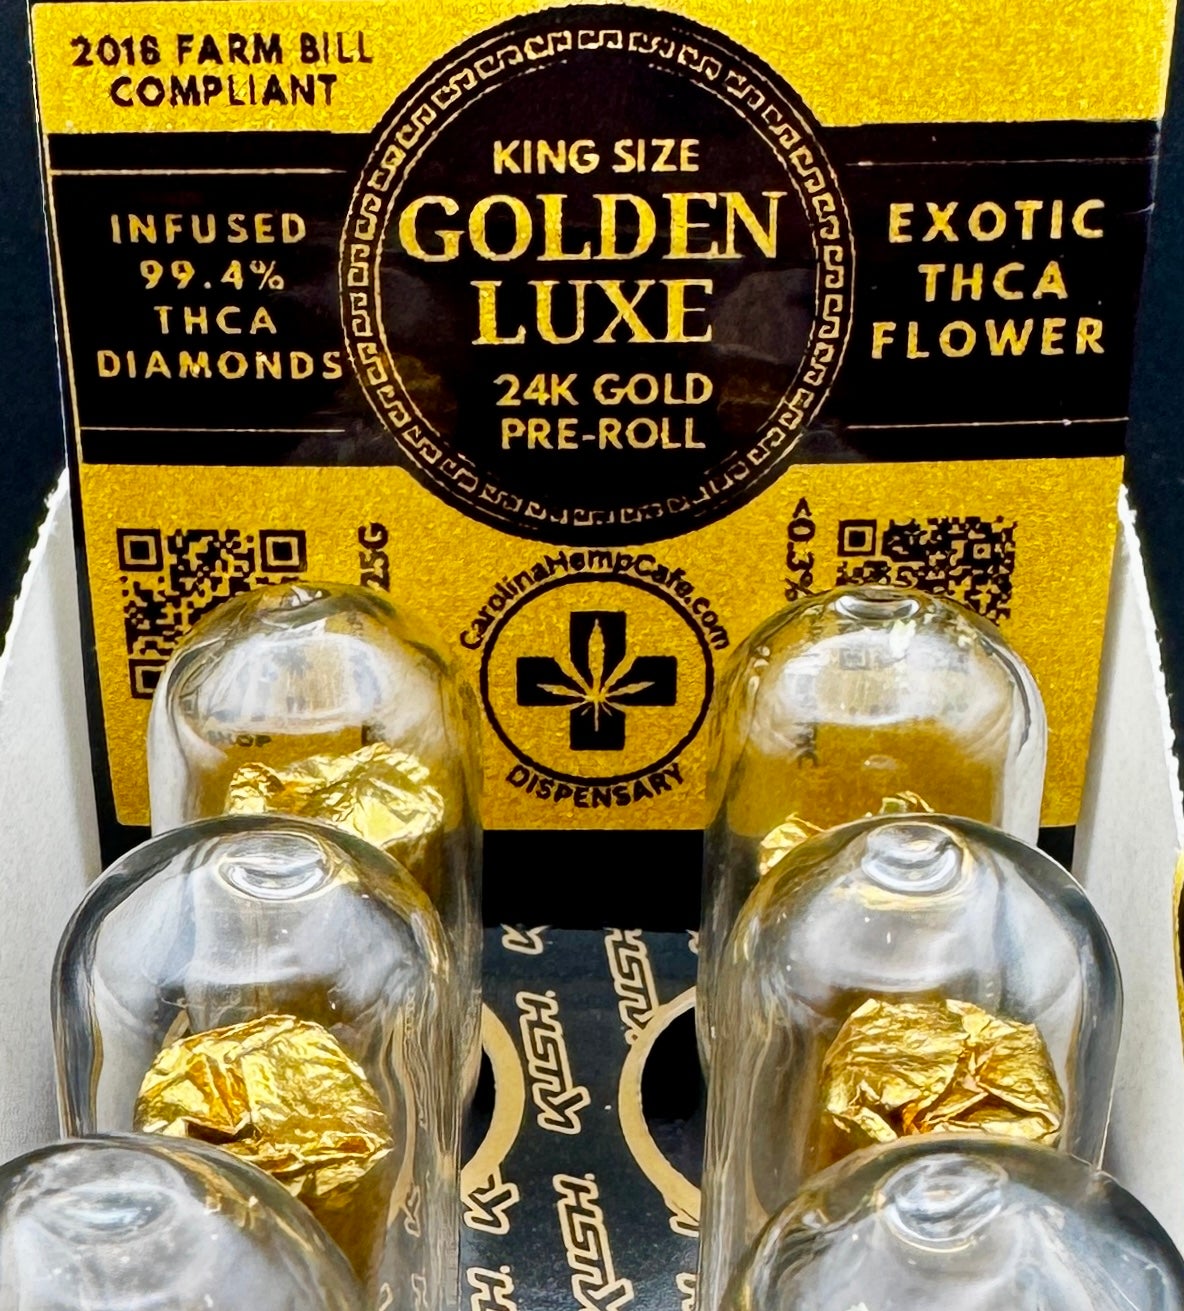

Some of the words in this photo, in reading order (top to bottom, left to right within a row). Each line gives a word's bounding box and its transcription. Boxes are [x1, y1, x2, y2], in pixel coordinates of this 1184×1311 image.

[176, 33, 283, 65] FARM
[300, 31, 373, 64] BILL
[109, 74, 337, 107] COMPLIANT
[494, 140, 600, 174] KING
[612, 138, 699, 173] SIZE
[110, 213, 306, 243] INFUSED
[399, 191, 788, 262] GOLDEN
[888, 200, 1105, 242] EXOTIC
[140, 260, 284, 290] 99.4%
[918, 261, 1068, 302] THCA
[155, 306, 277, 334] THCA
[470, 279, 713, 345] LUXE
[871, 318, 1105, 359] FLOWER
[97, 351, 343, 379] DIAMONDS
[493, 373, 579, 406] 24K
[593, 373, 713, 405] GOLD
[501, 417, 706, 450] PRE-ROLL
[505, 762, 684, 808] DISPENSARY
